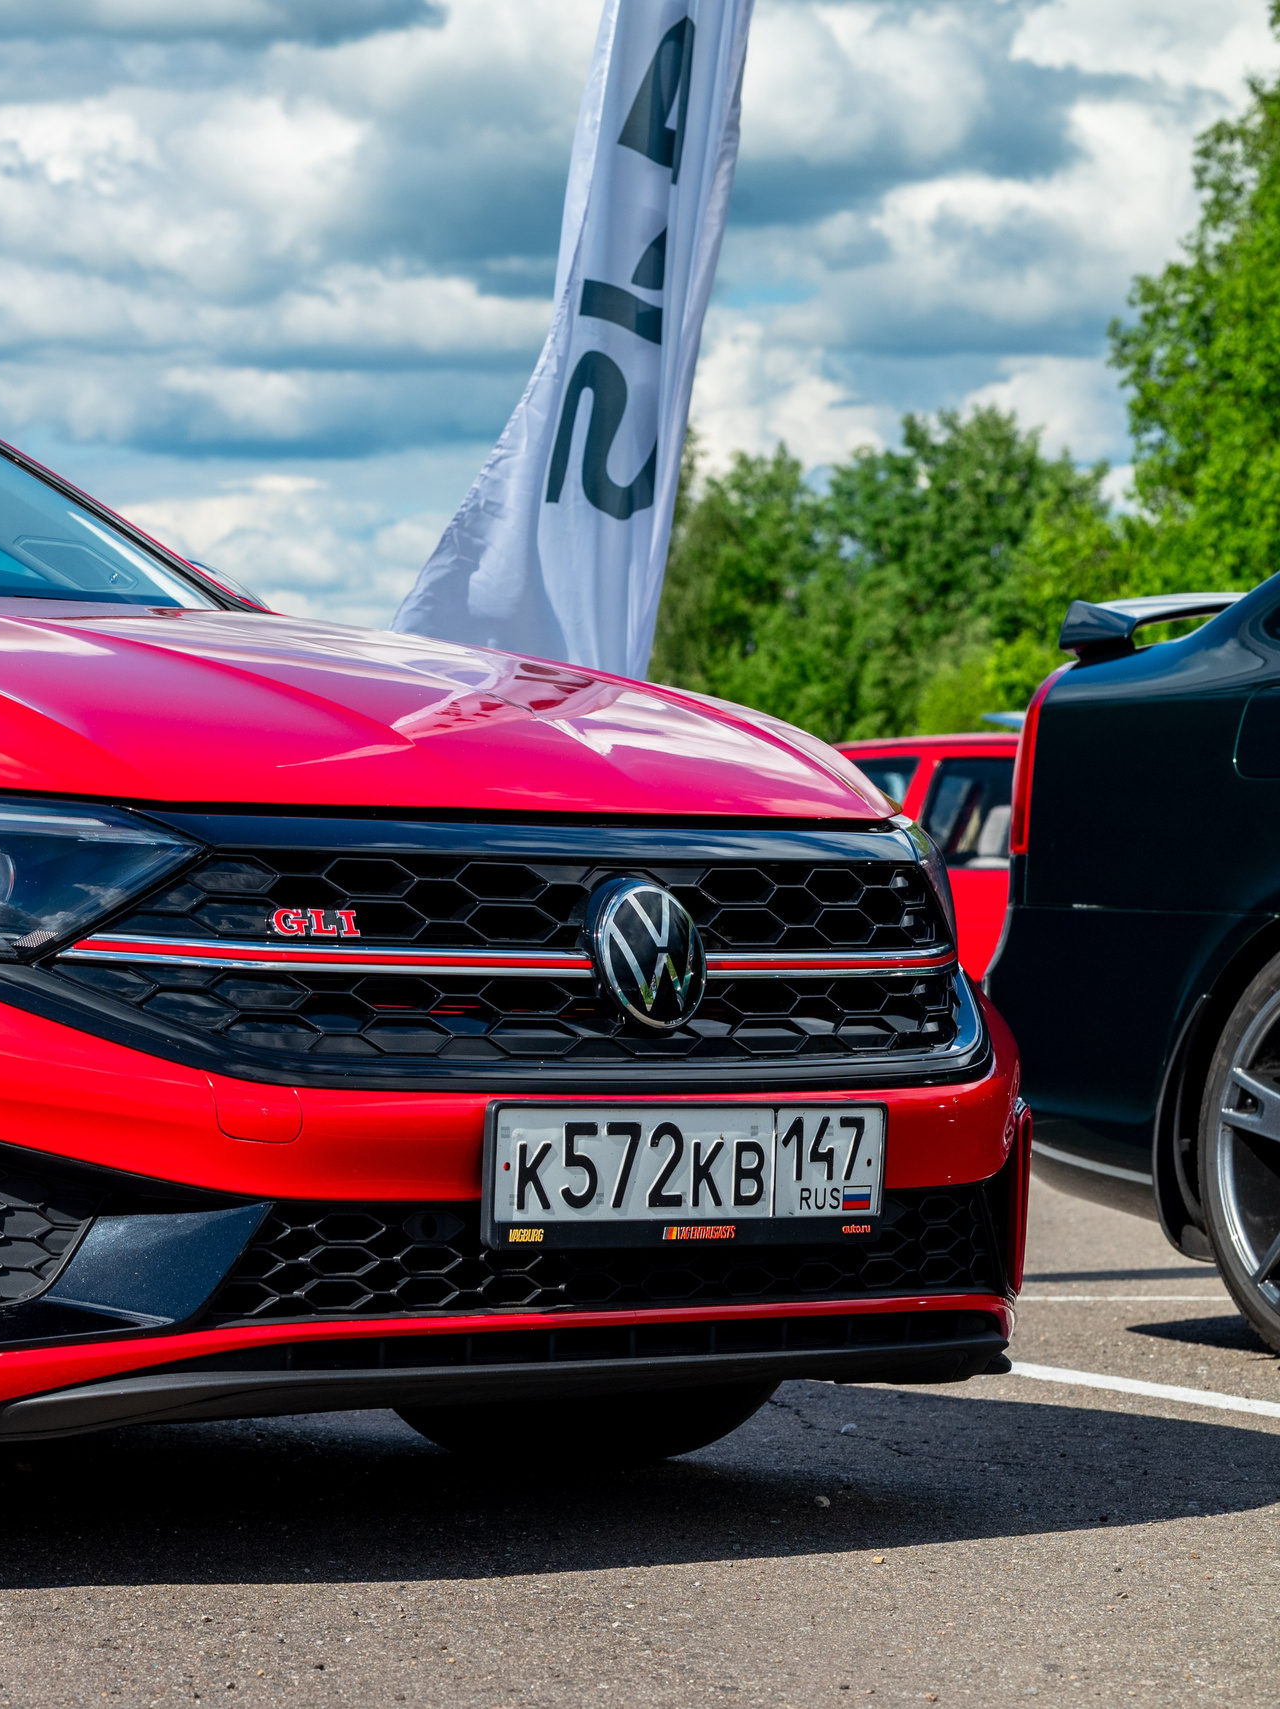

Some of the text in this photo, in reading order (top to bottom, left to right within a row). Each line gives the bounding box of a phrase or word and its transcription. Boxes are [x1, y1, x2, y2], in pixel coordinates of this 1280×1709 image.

[273, 908, 361, 937] GLI
[781, 1115, 866, 1182] 147
[799, 1187, 841, 1211] RUS
[509, 1229, 544, 1242] VAGBURG
[842, 1224, 871, 1233] auto.ru
